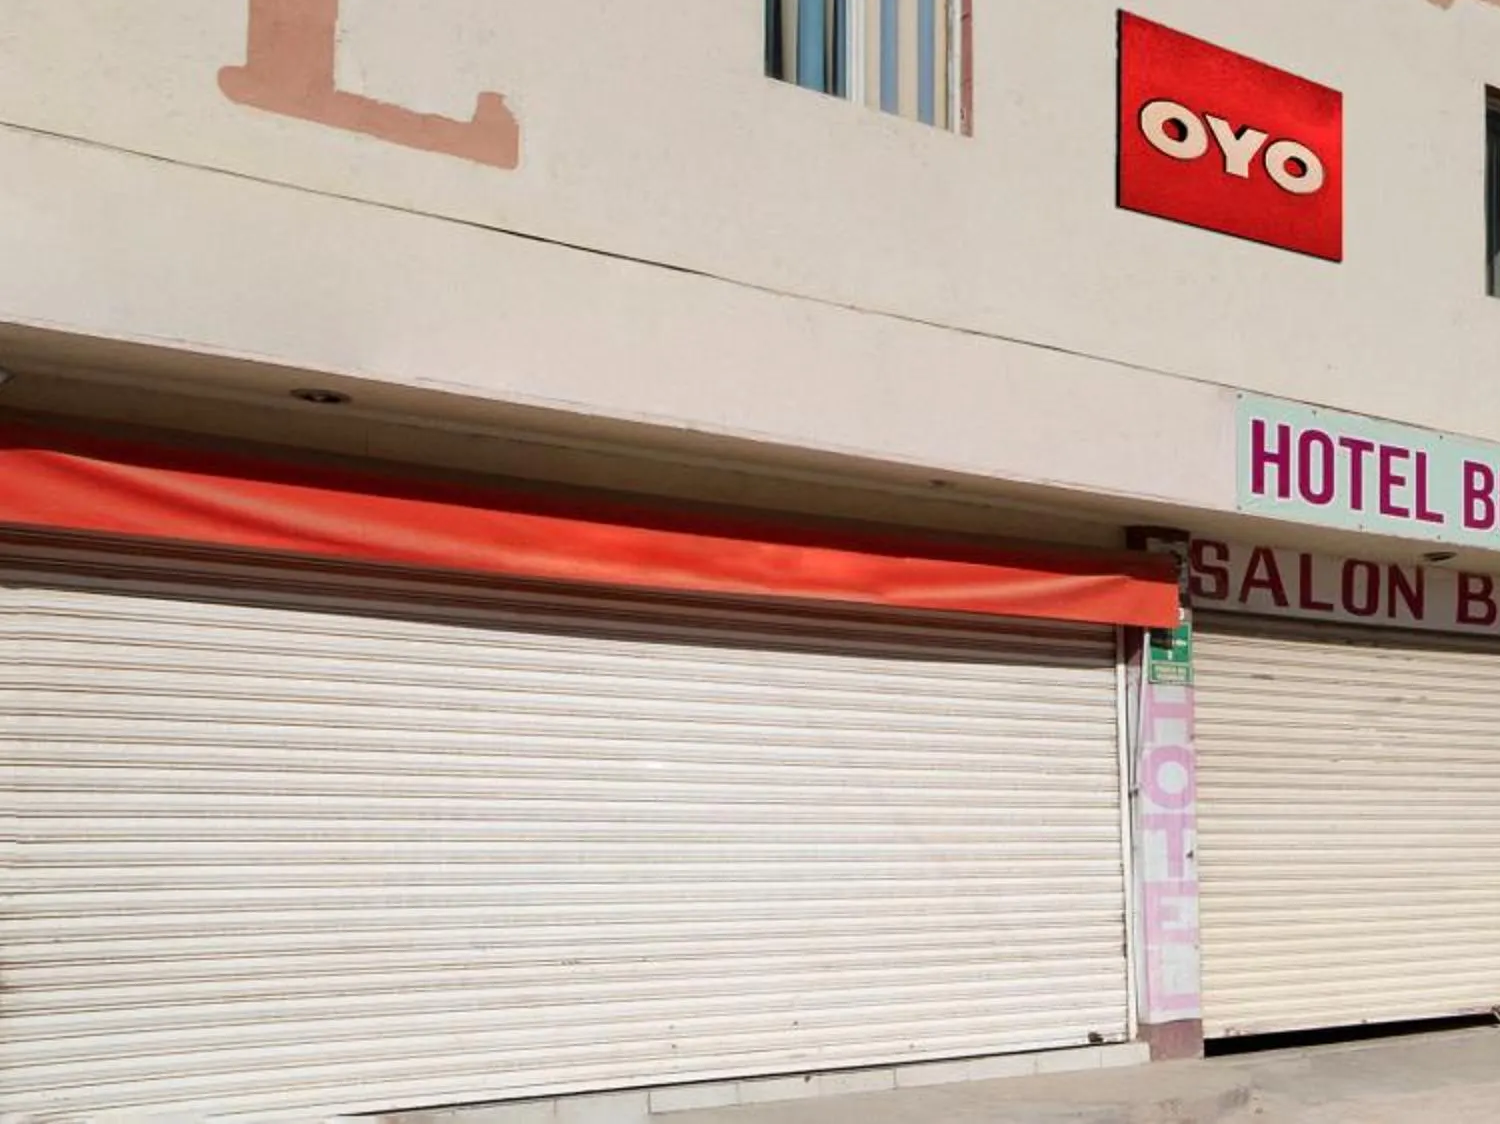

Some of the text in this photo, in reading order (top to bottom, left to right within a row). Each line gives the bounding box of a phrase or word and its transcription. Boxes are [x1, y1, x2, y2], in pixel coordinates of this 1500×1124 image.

[1139, 98, 1326, 195] OYO
[1250, 418, 1445, 525] HOTEL
[1189, 538, 1424, 621] SALON
